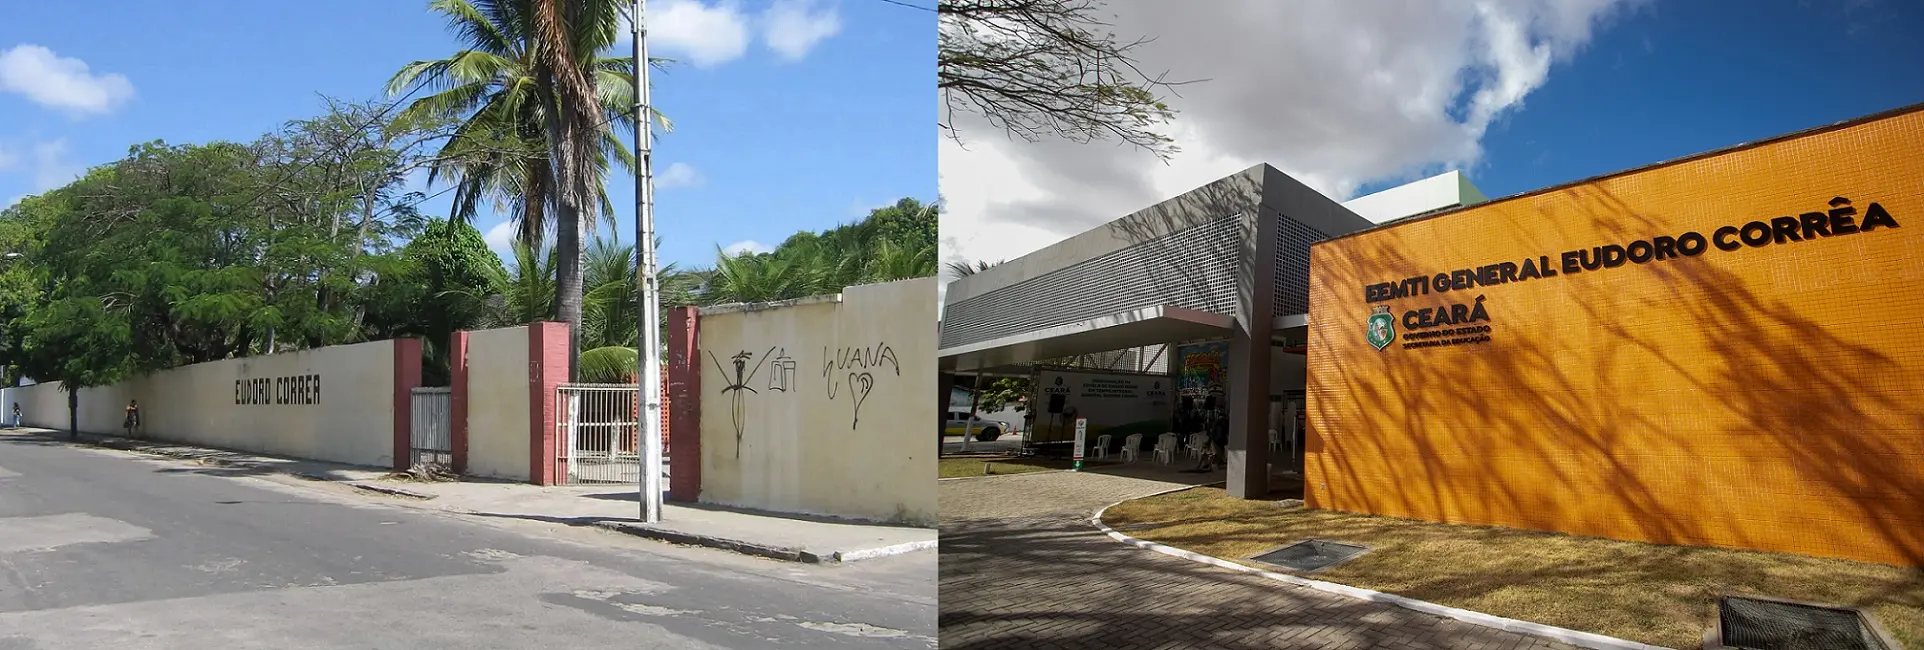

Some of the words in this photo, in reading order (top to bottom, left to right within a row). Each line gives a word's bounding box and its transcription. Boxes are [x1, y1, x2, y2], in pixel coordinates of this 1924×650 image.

[1365, 275, 1429, 303] EEMTI
[1432, 255, 1556, 293] GENERAL
[1561, 231, 1708, 274] EUDORO
[1712, 196, 1900, 252] CORRÊA
[1402, 294, 1491, 330] CEARÁ
[1403, 330, 1441, 340] GOVERNO
[1442, 328, 1455, 337] DO
[1456, 325, 1491, 335] ESTADO
[1403, 340, 1441, 349] SECRETARIA
[1442, 338, 1453, 346] DA
[1453, 335, 1491, 345] EDUCAÇÃO
[235, 377, 271, 405] EUDORO
